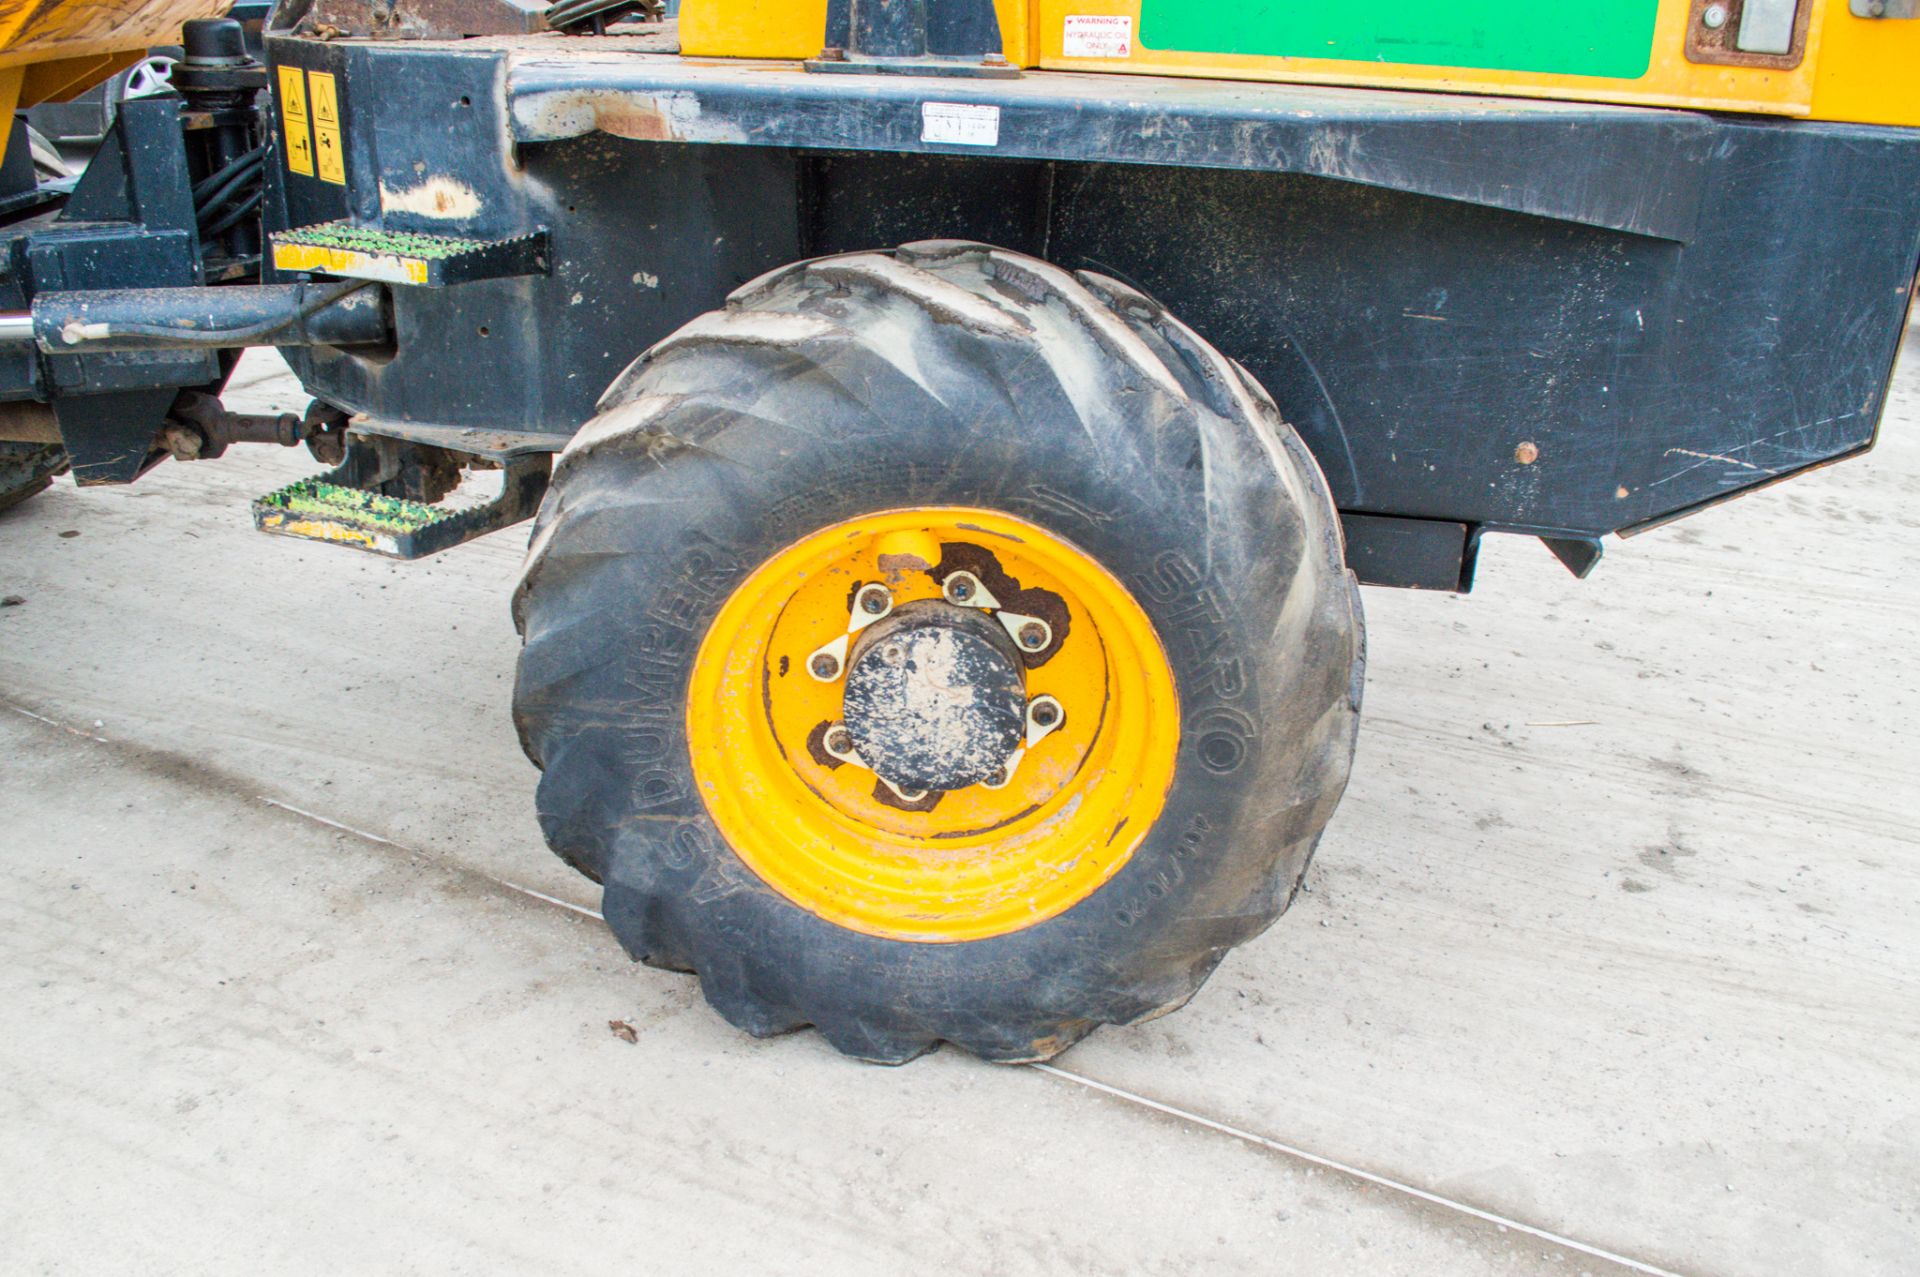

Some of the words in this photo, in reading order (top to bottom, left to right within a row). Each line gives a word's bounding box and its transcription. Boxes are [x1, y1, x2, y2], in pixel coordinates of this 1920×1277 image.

[1086, 42, 1109, 50] ONLY
[620, 546, 738, 812] DUMPER
[1133, 548, 1256, 775] STARCO
